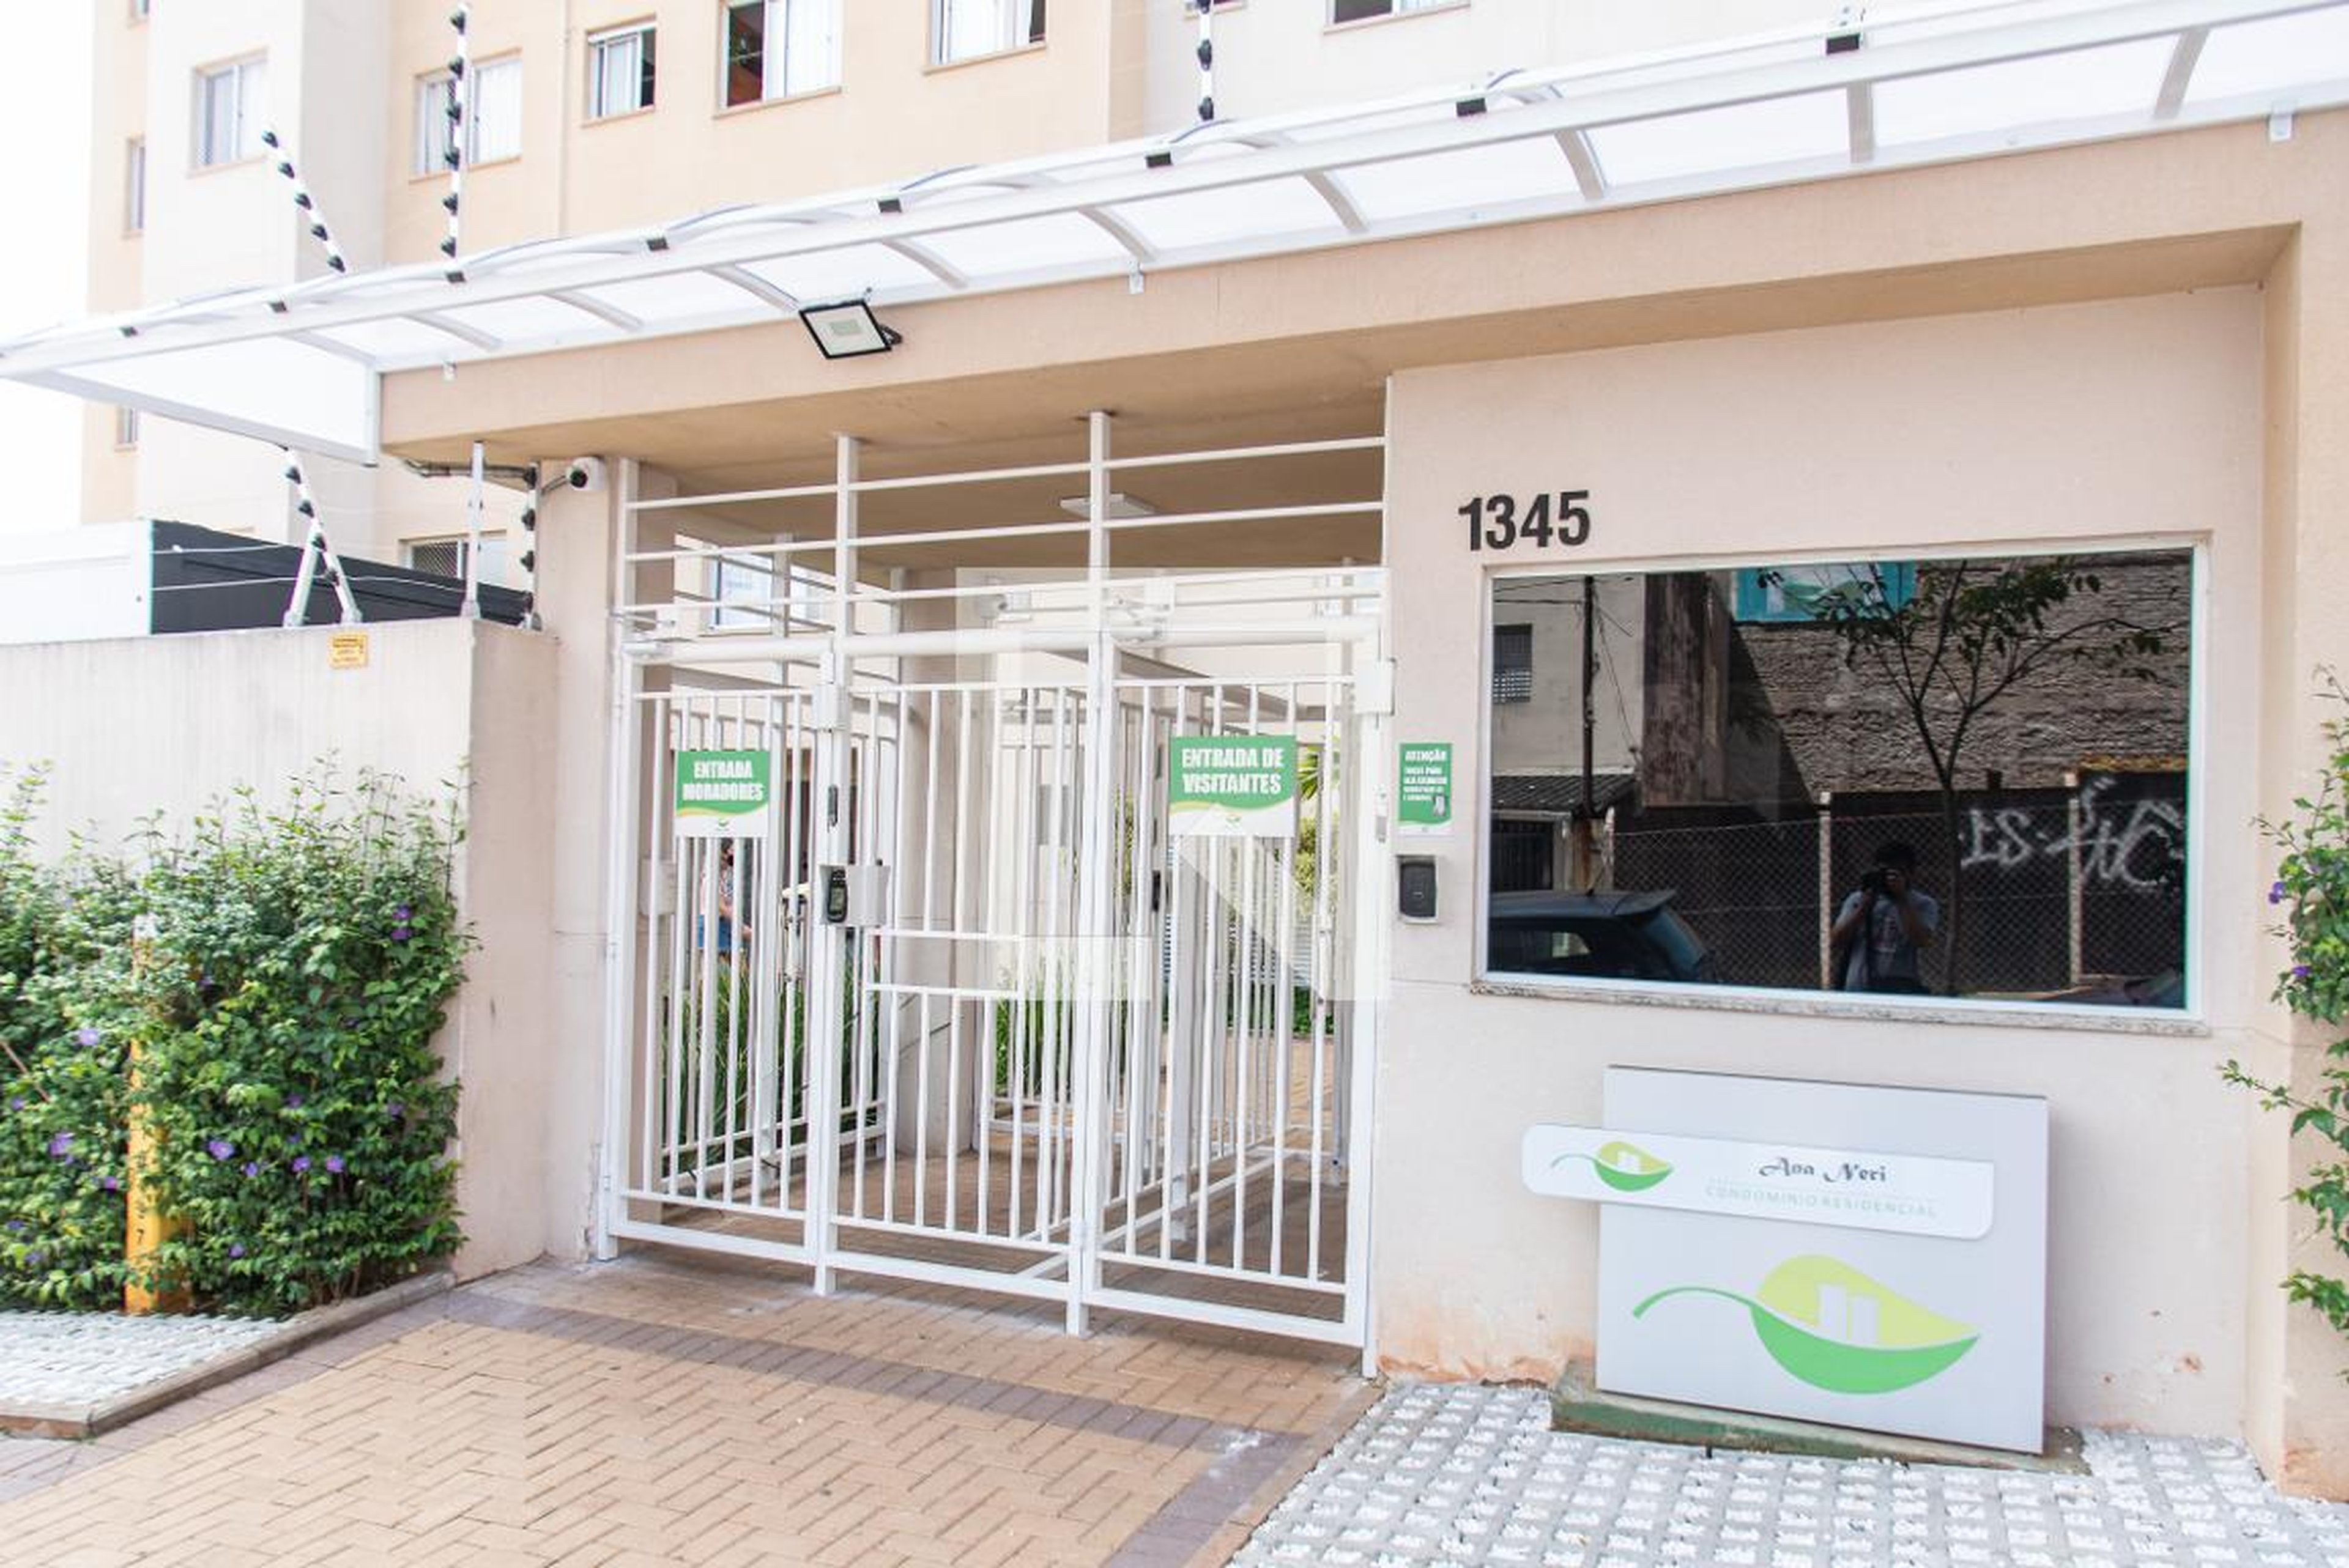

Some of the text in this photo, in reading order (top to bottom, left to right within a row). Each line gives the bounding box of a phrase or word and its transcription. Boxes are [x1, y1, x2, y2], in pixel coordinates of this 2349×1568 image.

[1458, 490, 1590, 551] 1345
[1182, 747, 1285, 768] ENTRADA DE
[694, 760, 753, 778] ENTRADA
[682, 782, 765, 801] MORADORES
[1182, 773, 1282, 794] VISITANTES
[1758, 1156, 1887, 1183] Ana Neri
